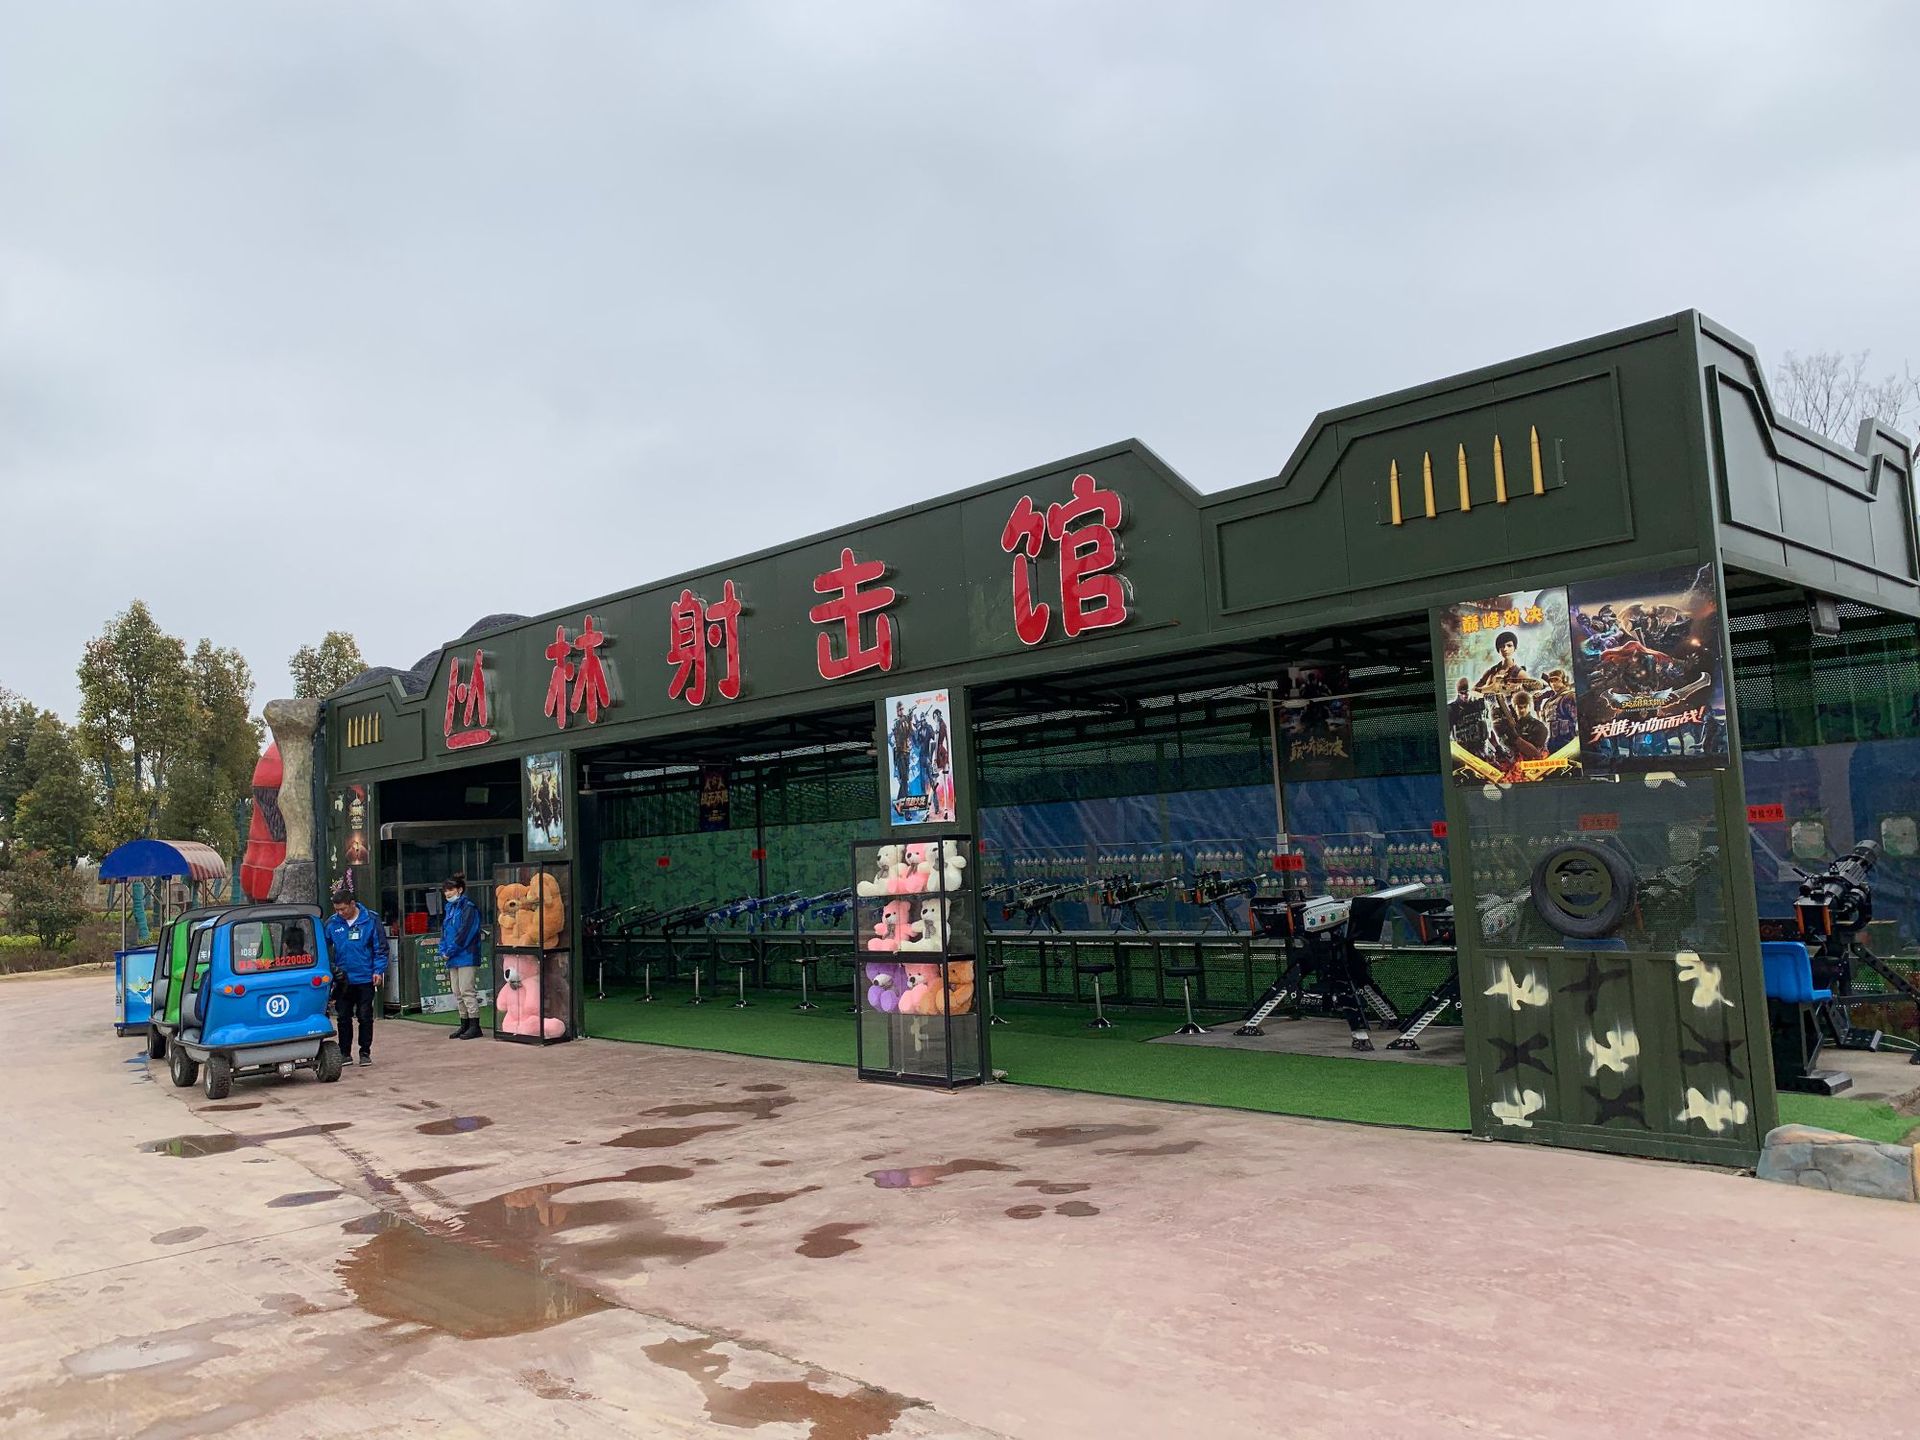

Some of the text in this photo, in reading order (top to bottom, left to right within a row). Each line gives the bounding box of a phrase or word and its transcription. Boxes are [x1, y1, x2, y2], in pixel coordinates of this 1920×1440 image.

[443, 473, 1131, 750] 丛林射击馆
[1461, 605, 1544, 633] 巅峰对决
[272, 998, 285, 1012] 91
